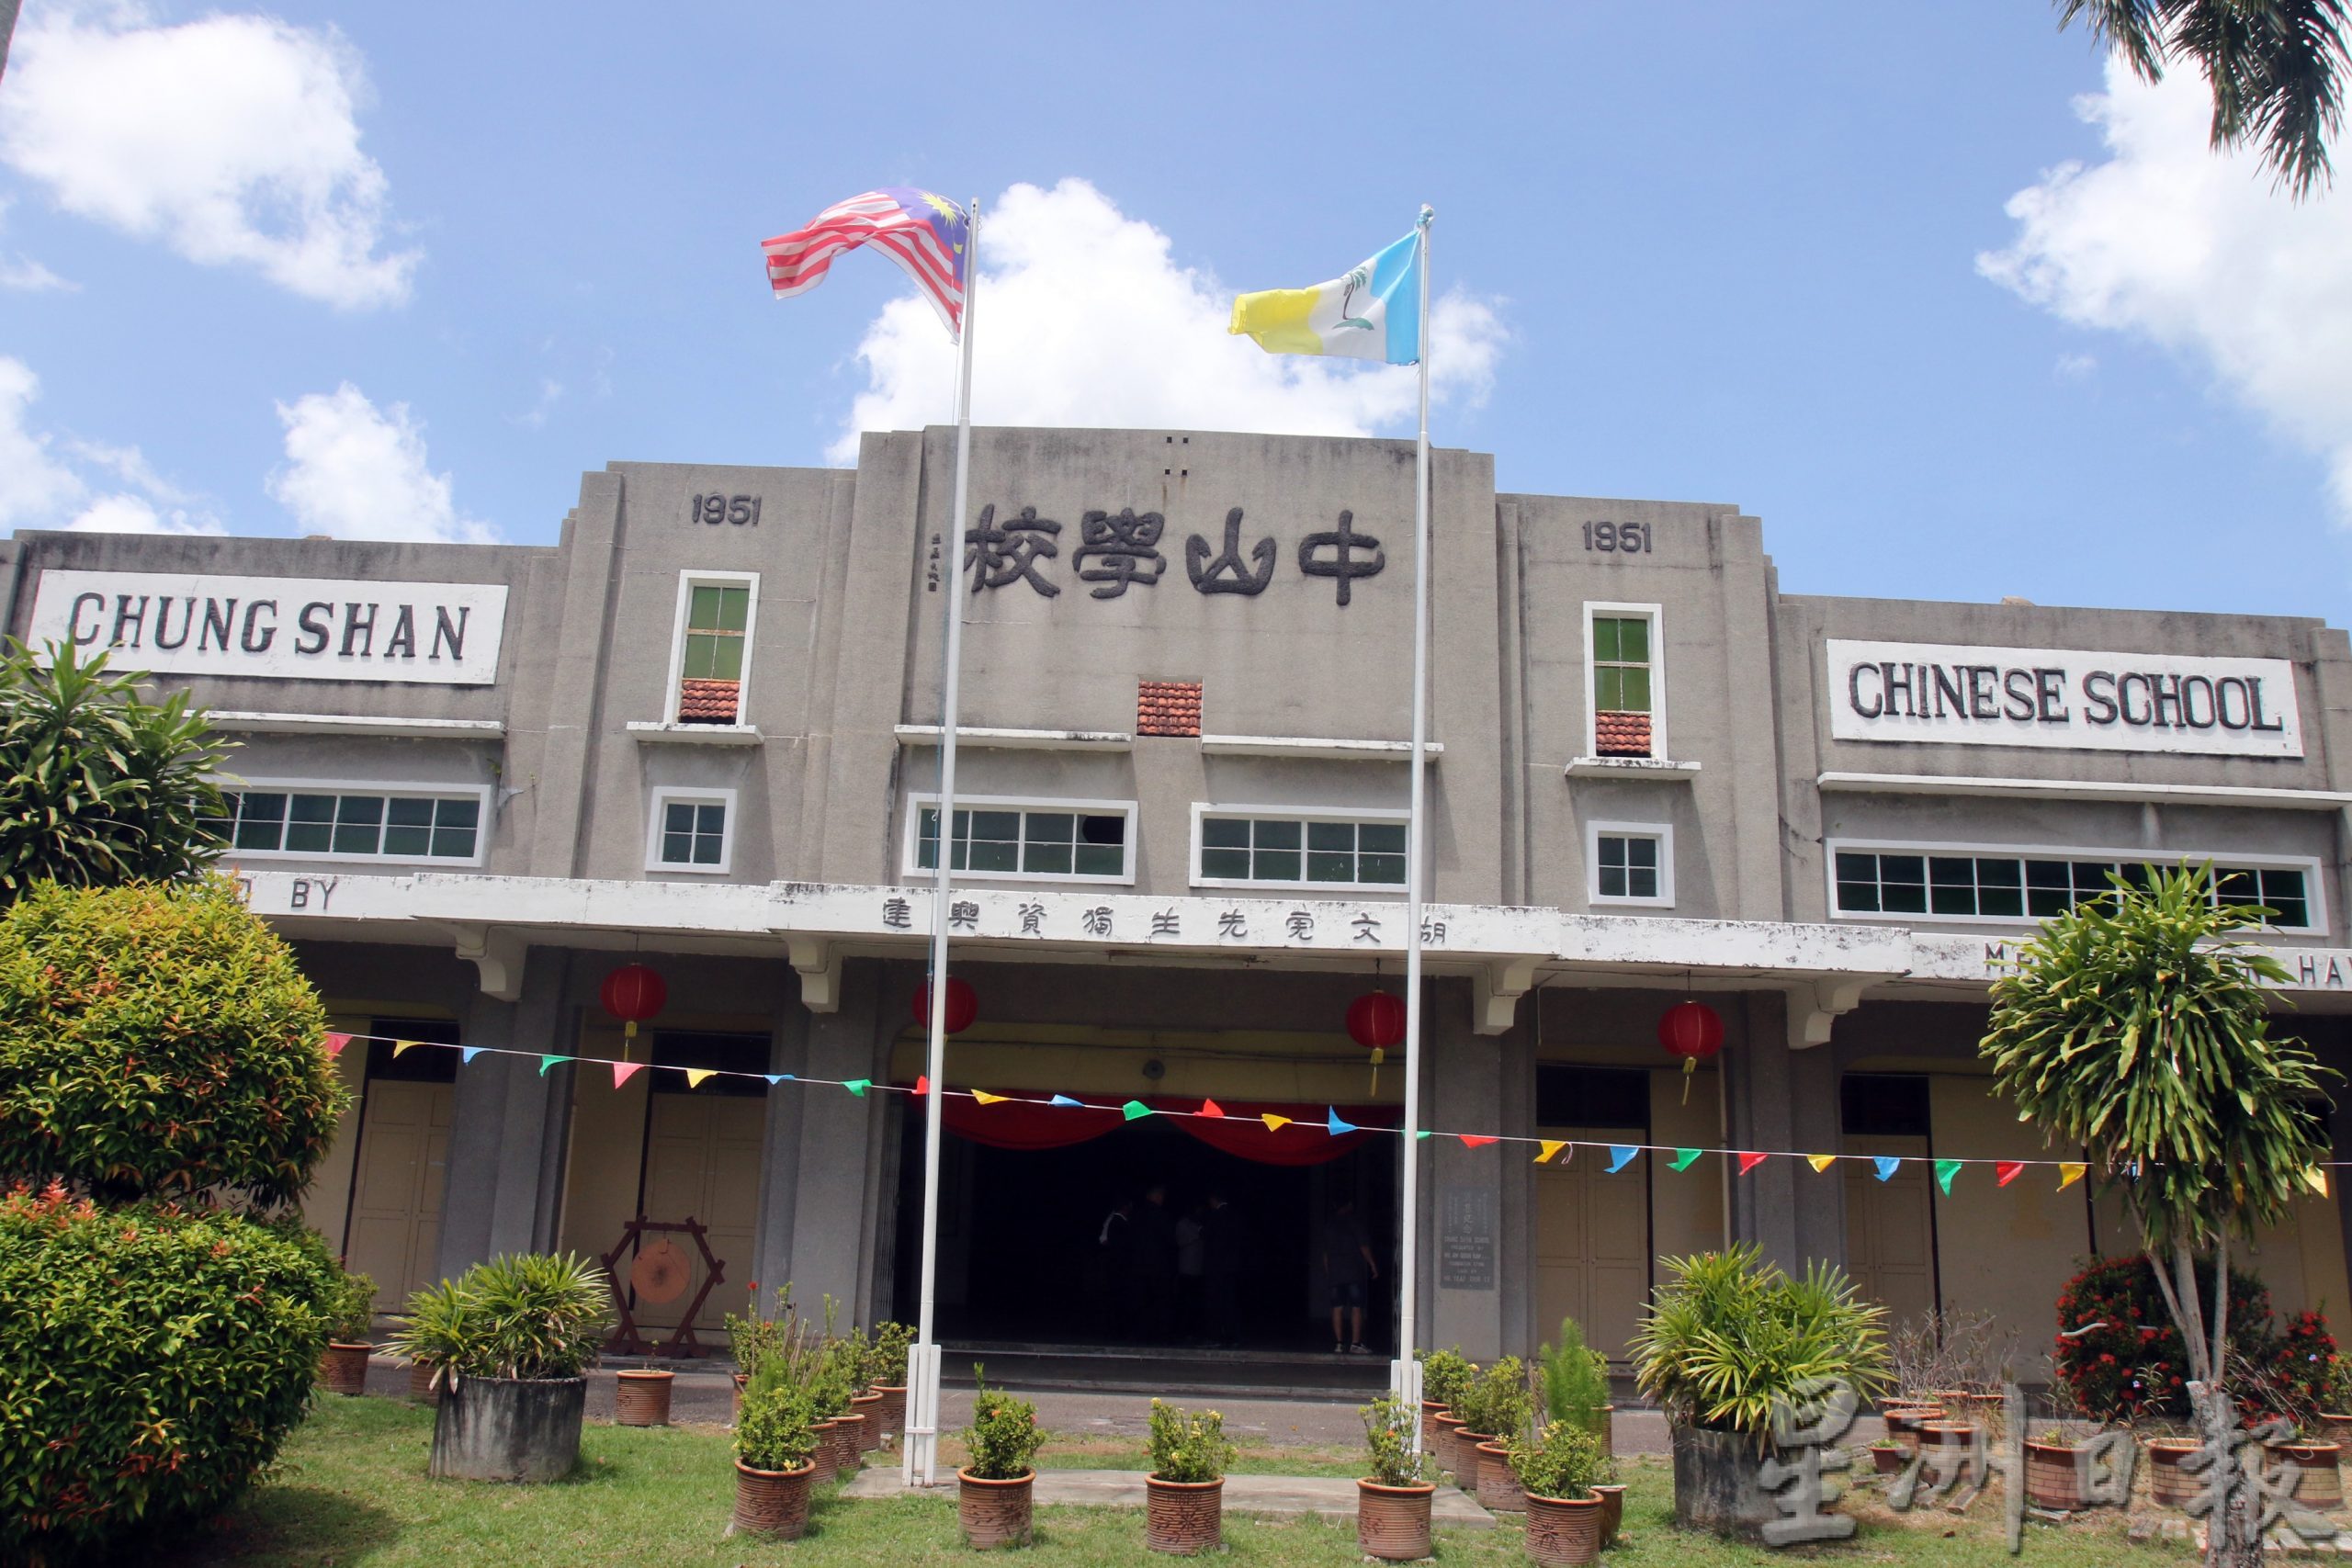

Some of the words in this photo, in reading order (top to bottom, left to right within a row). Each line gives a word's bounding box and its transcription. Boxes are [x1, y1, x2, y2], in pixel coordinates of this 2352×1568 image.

[692, 493, 762, 525] 1951
[963, 503, 1385, 605] 中山學校
[1582, 520, 1652, 553] 1951
[69, 591, 278, 654] CHUNG
[294, 601, 471, 660] SHAN
[1848, 660, 2069, 723] CHINESE
[2082, 670, 2284, 732] SCHOOL
[290, 875, 339, 910] BY
[2298, 954, 2352, 985] HA
